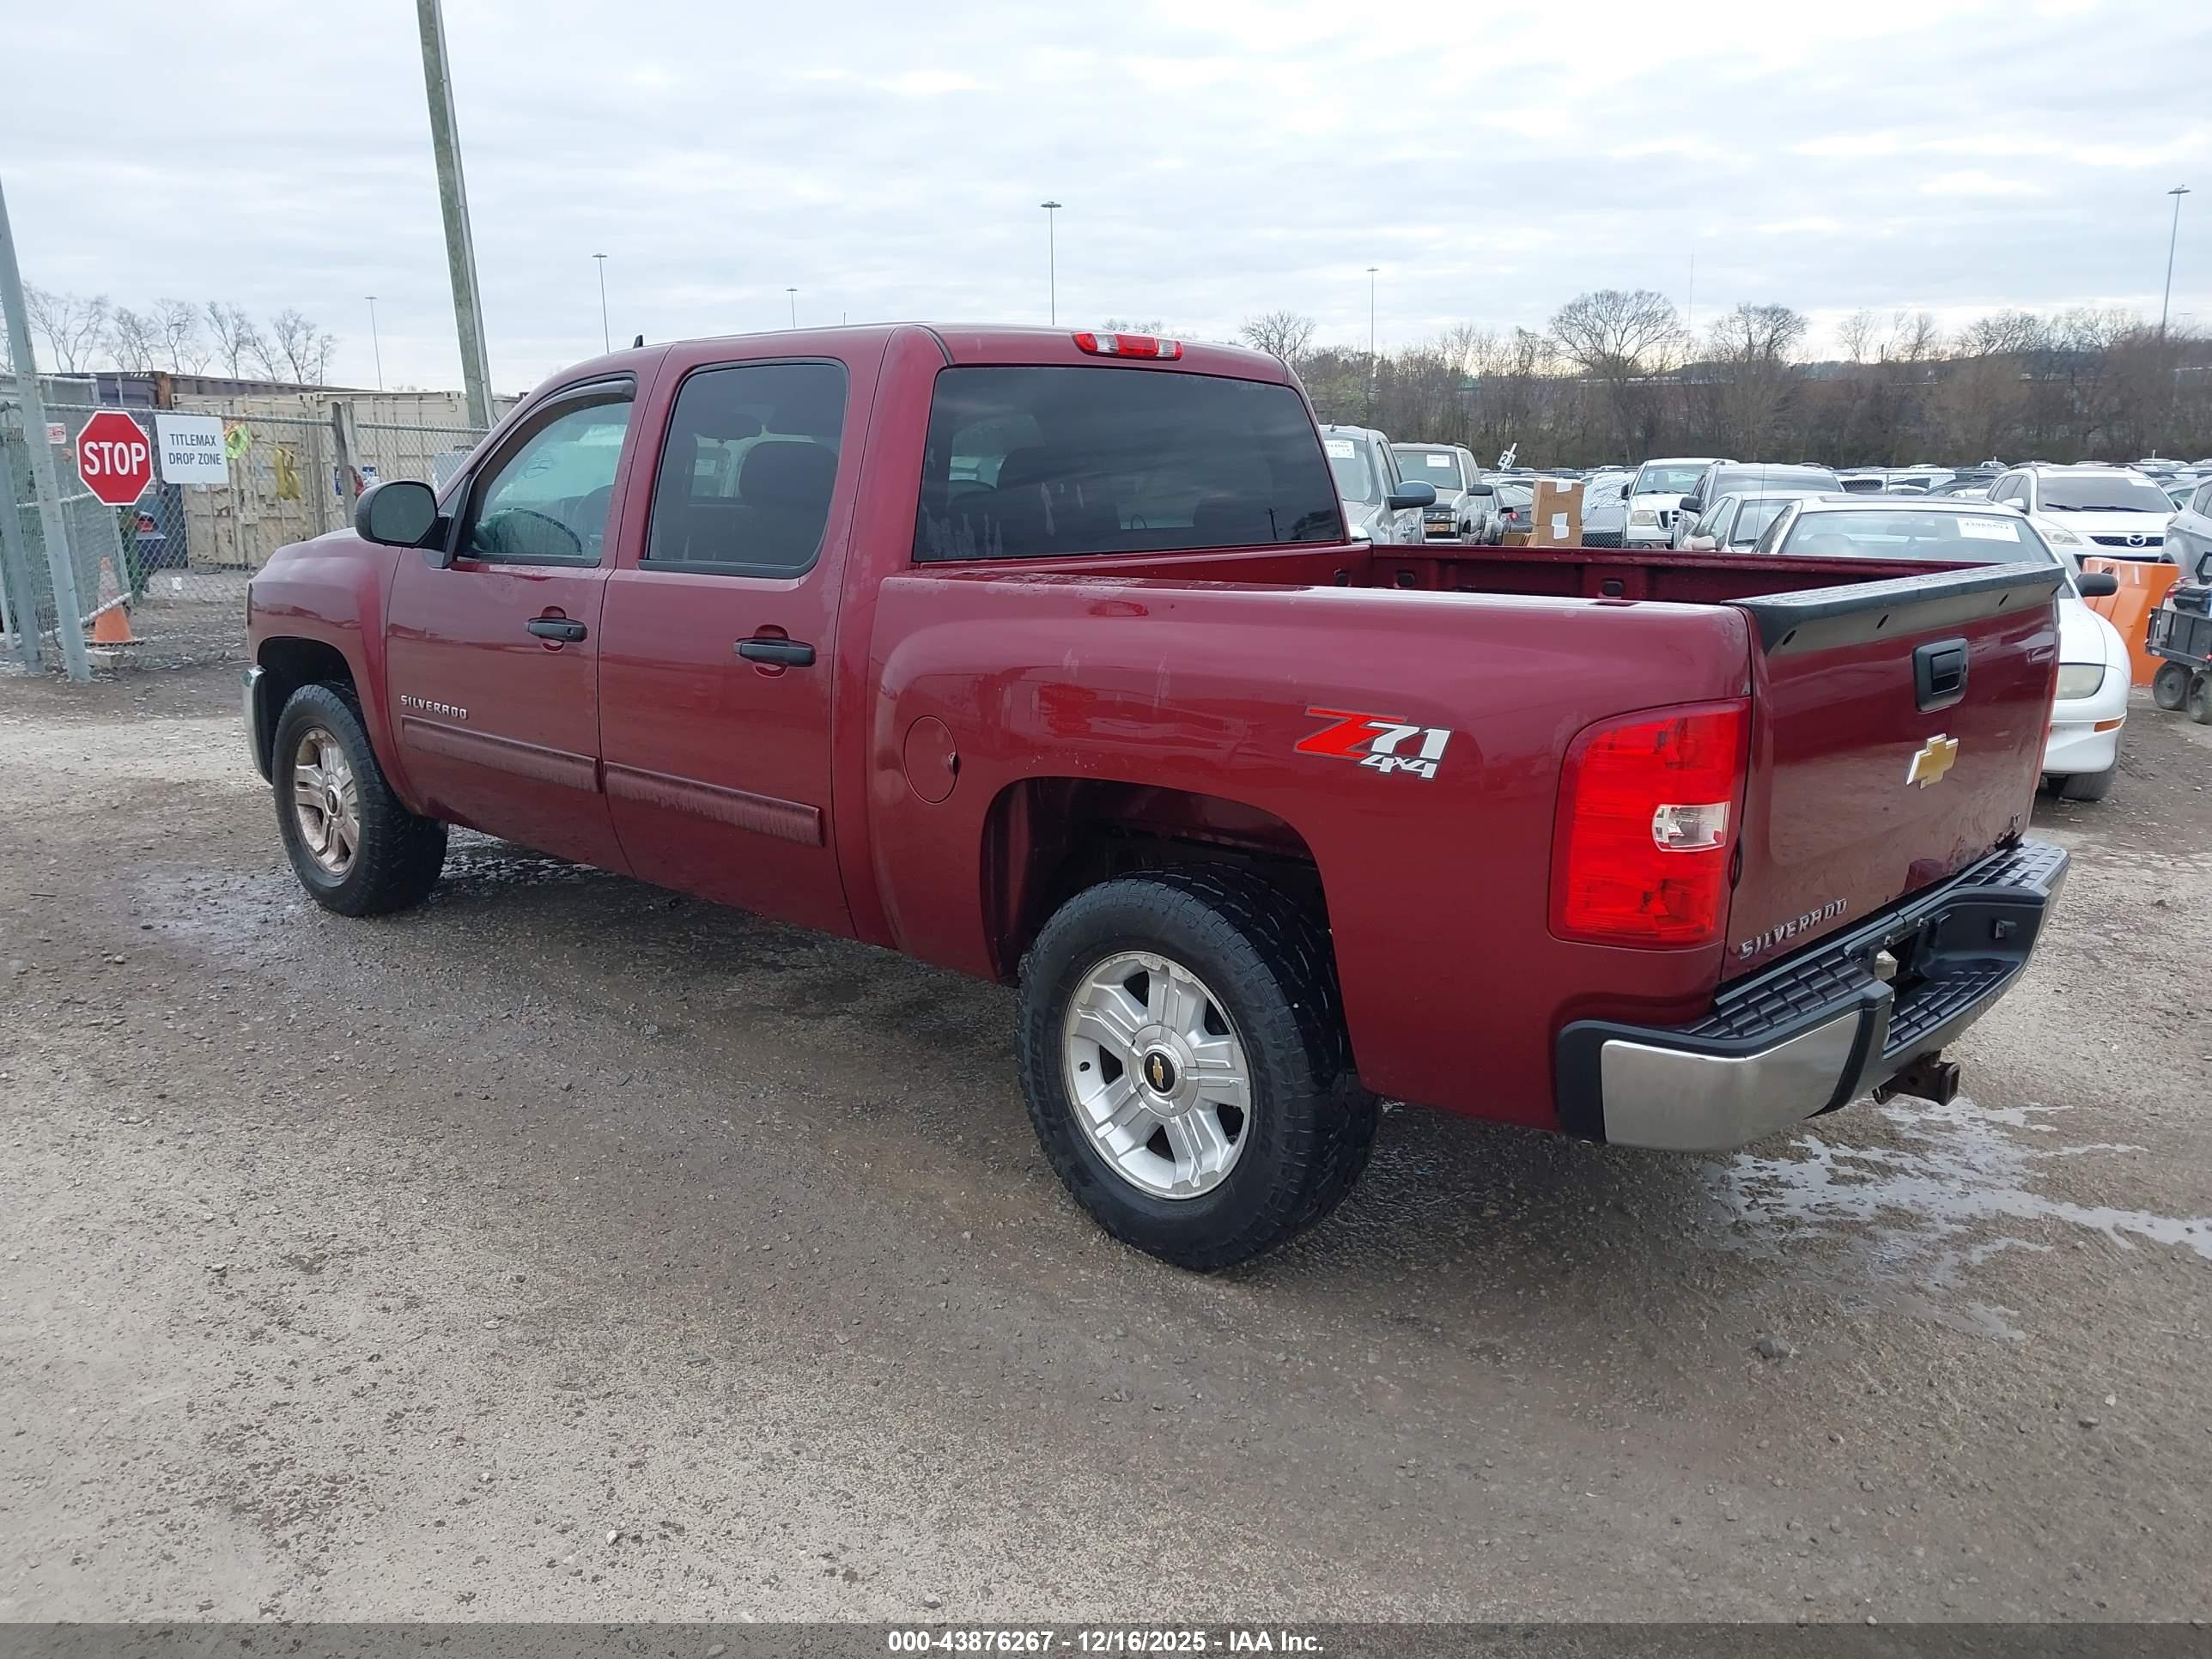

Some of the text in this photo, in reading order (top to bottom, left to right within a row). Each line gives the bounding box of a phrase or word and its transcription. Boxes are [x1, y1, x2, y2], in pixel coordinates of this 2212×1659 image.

[169, 433, 217, 447] TITLEMAX
[83, 441, 146, 476] STOP
[168, 452, 222, 465] DROP ZONE
[399, 694, 468, 720] SILVERADO
[1293, 707, 1453, 761] Z71
[1738, 897, 1848, 961] SILVERADO
